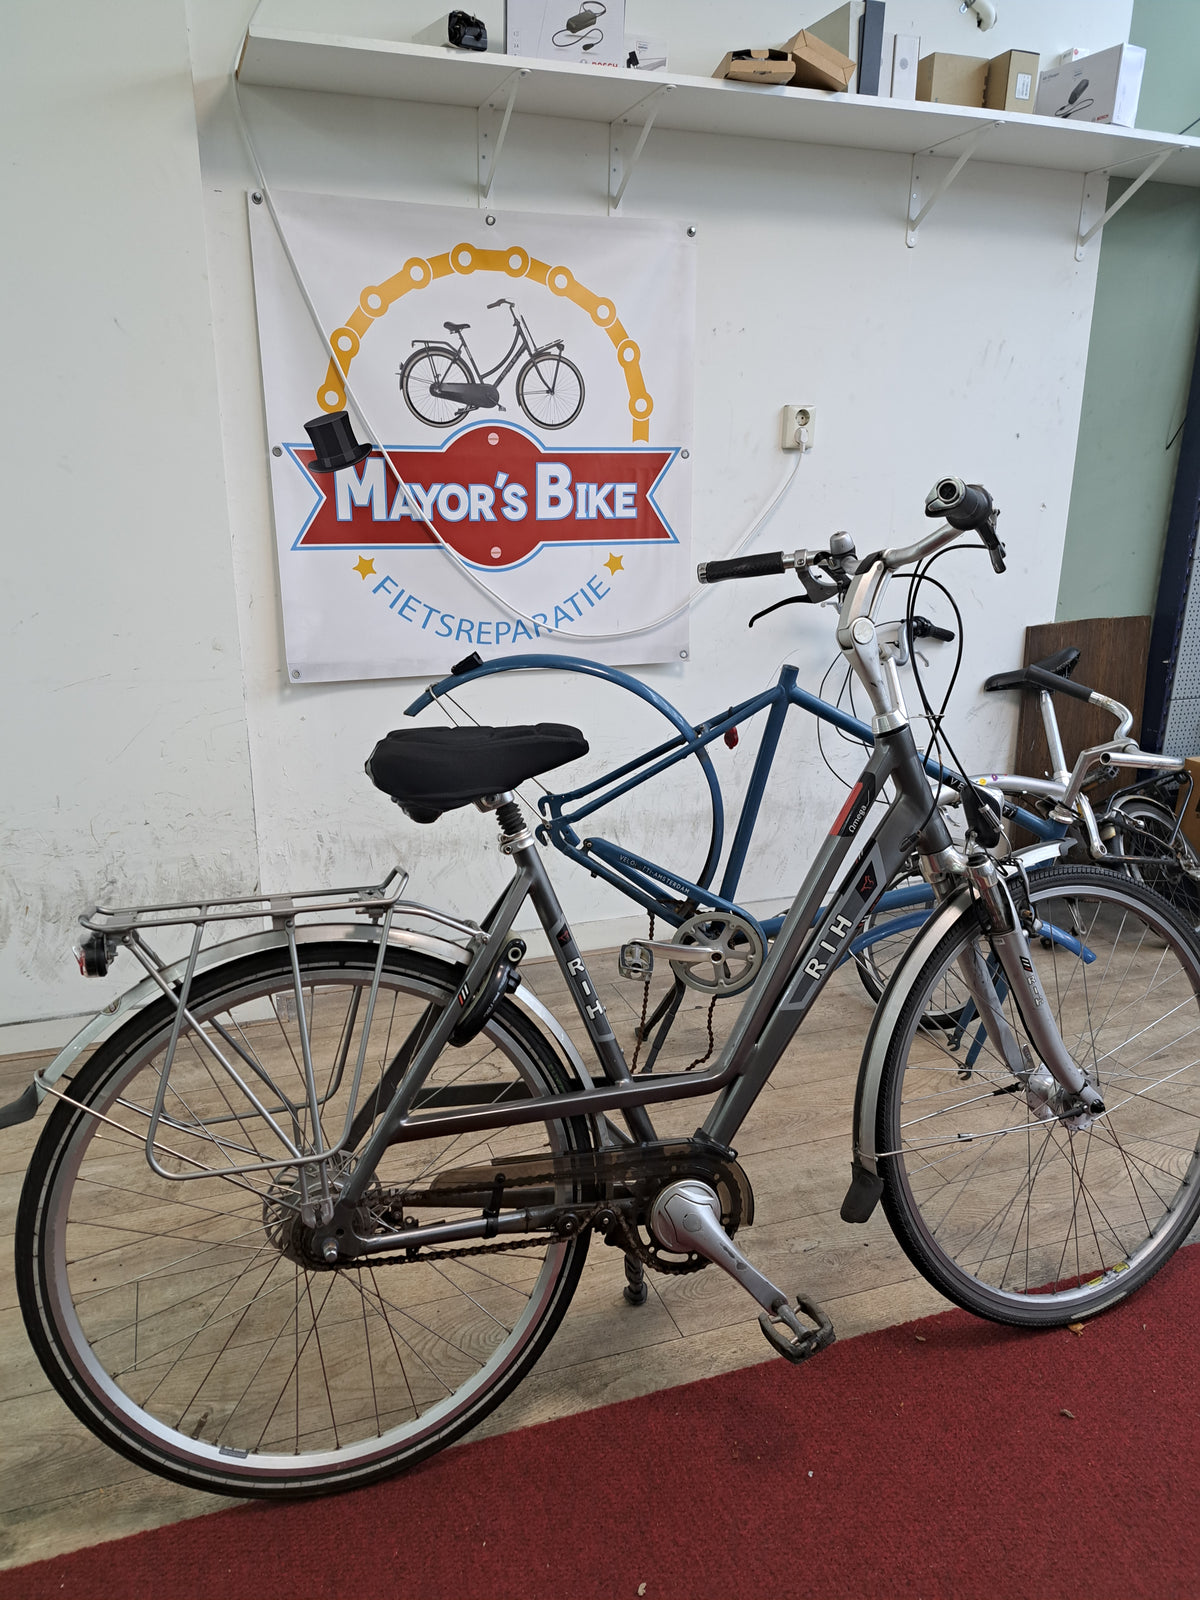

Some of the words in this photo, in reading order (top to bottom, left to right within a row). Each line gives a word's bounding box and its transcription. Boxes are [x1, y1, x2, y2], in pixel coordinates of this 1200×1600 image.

[372, 574, 611, 645] FIETSREPARATIE
[804, 914, 853, 980] RIH
[567, 957, 603, 1019] RIH
